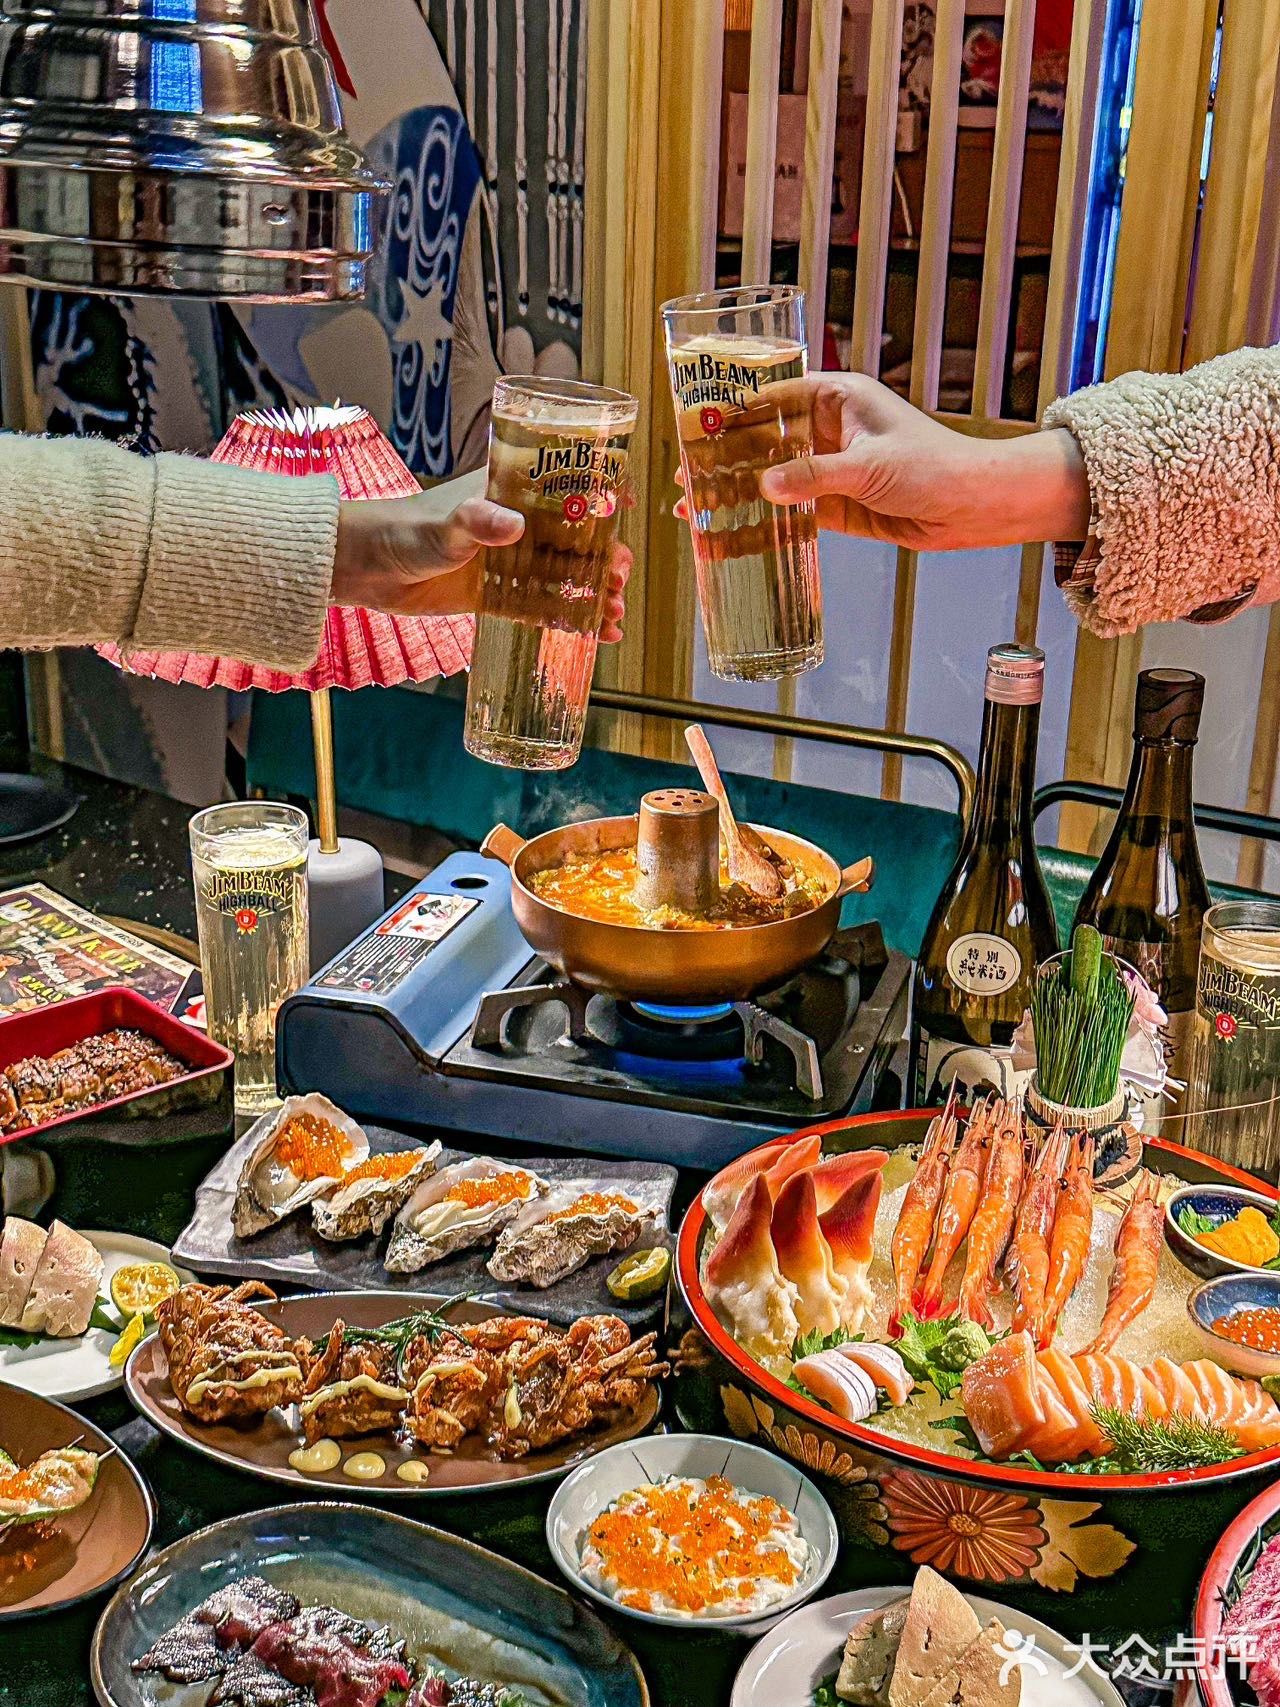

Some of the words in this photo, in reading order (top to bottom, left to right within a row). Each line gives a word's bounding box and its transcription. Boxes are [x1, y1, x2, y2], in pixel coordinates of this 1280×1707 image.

[674, 361, 697, 394] JIM
[699, 354, 759, 394] BEAM
[682, 386, 748, 411] HIGHBALL
[529, 446, 572, 480] JIM
[574, 441, 620, 485] BEAM
[208, 874, 237, 900] JIM
[239, 870, 287, 901] BEAM
[219, 894, 277, 912] HIGHBALL
[958, 958, 1007, 980] 純米酒
[967, 947, 999, 963] 特別
[1199, 963, 1224, 993] JIM
[1224, 969, 1277, 1021] BEAM
